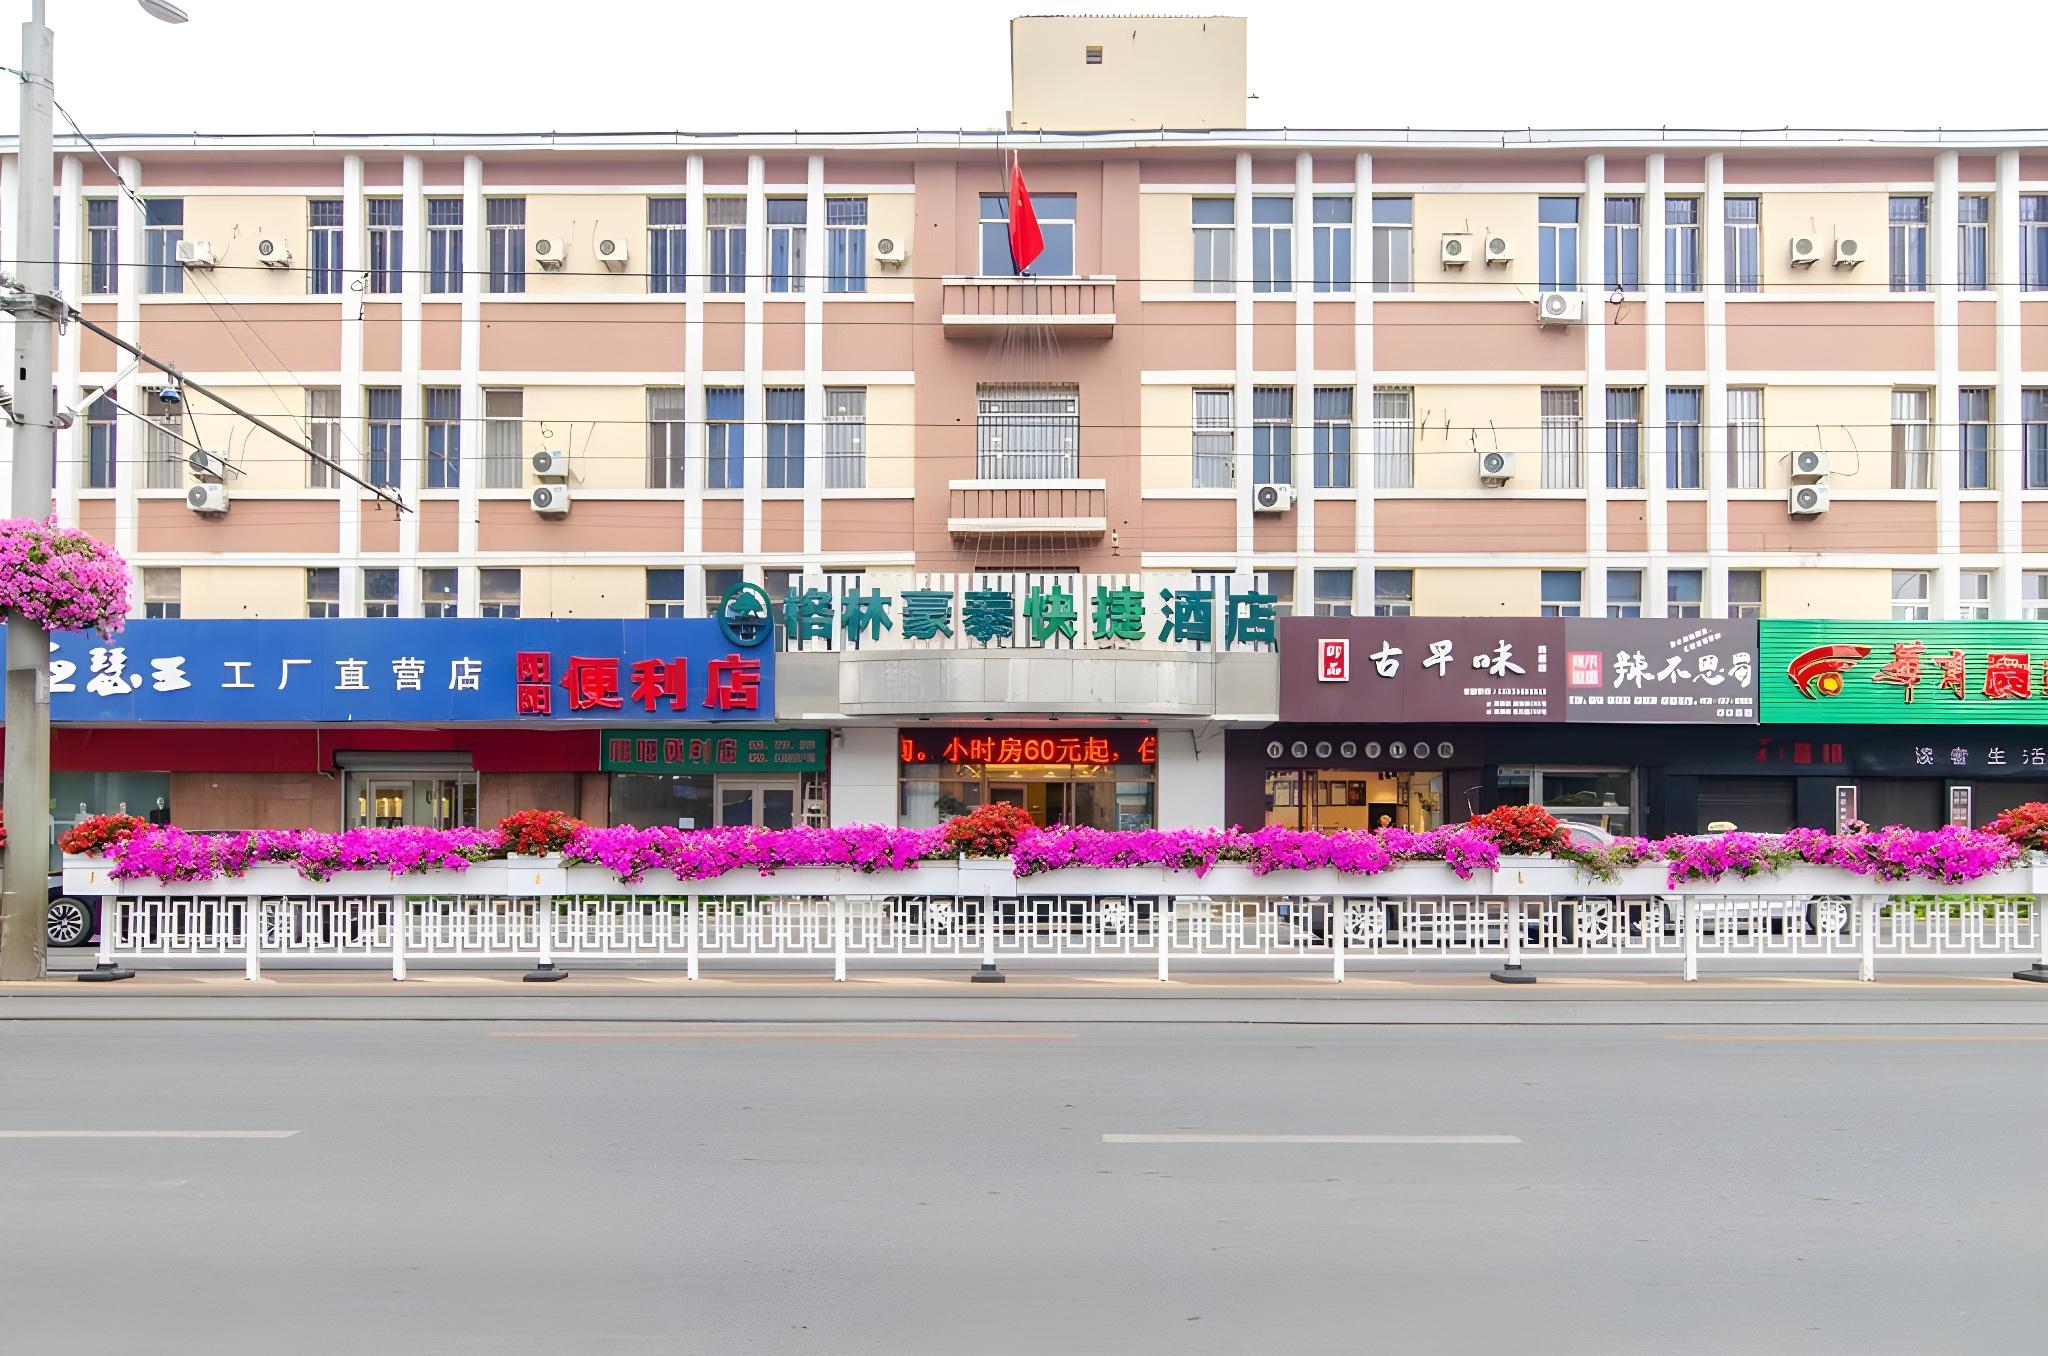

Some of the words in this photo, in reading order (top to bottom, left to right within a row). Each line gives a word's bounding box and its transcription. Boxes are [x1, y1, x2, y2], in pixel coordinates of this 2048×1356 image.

[221, 656, 482, 691] 工厂直营店
[1369, 639, 1526, 678] 古早味
[1613, 650, 1752, 689] 辣不思蜀
[560, 653, 761, 712] 便利店
